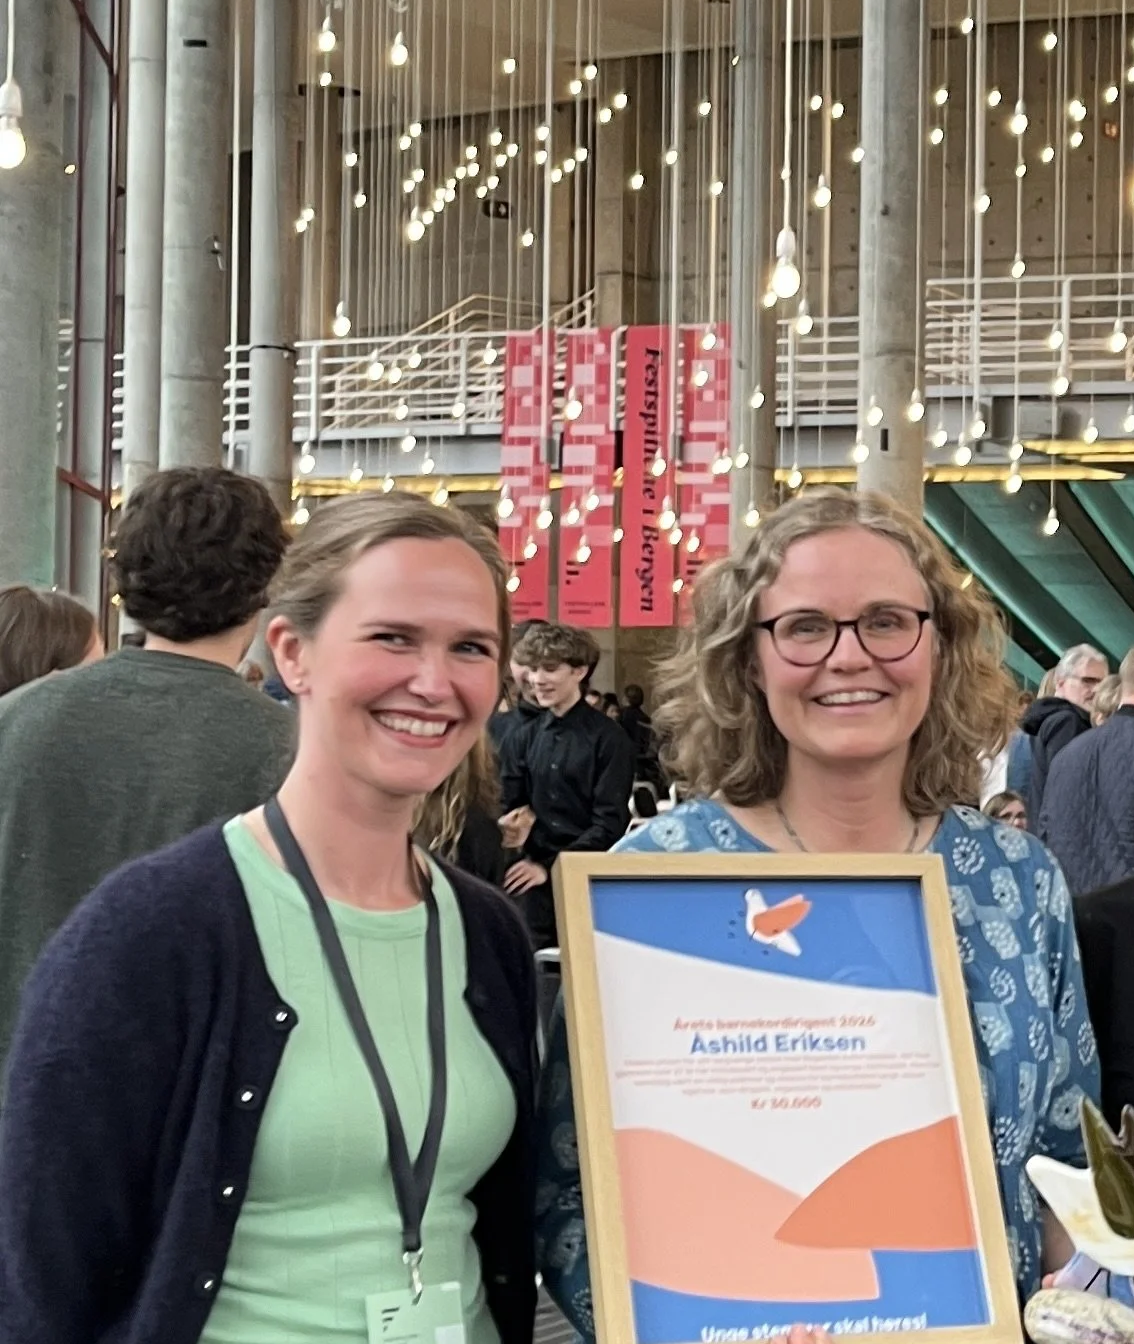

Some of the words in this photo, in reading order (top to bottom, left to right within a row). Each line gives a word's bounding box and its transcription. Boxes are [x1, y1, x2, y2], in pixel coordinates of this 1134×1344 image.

[634, 524, 660, 613] Bergen
[690, 1031, 768, 1054] Åshild
[775, 1032, 866, 1052] Eriksen
